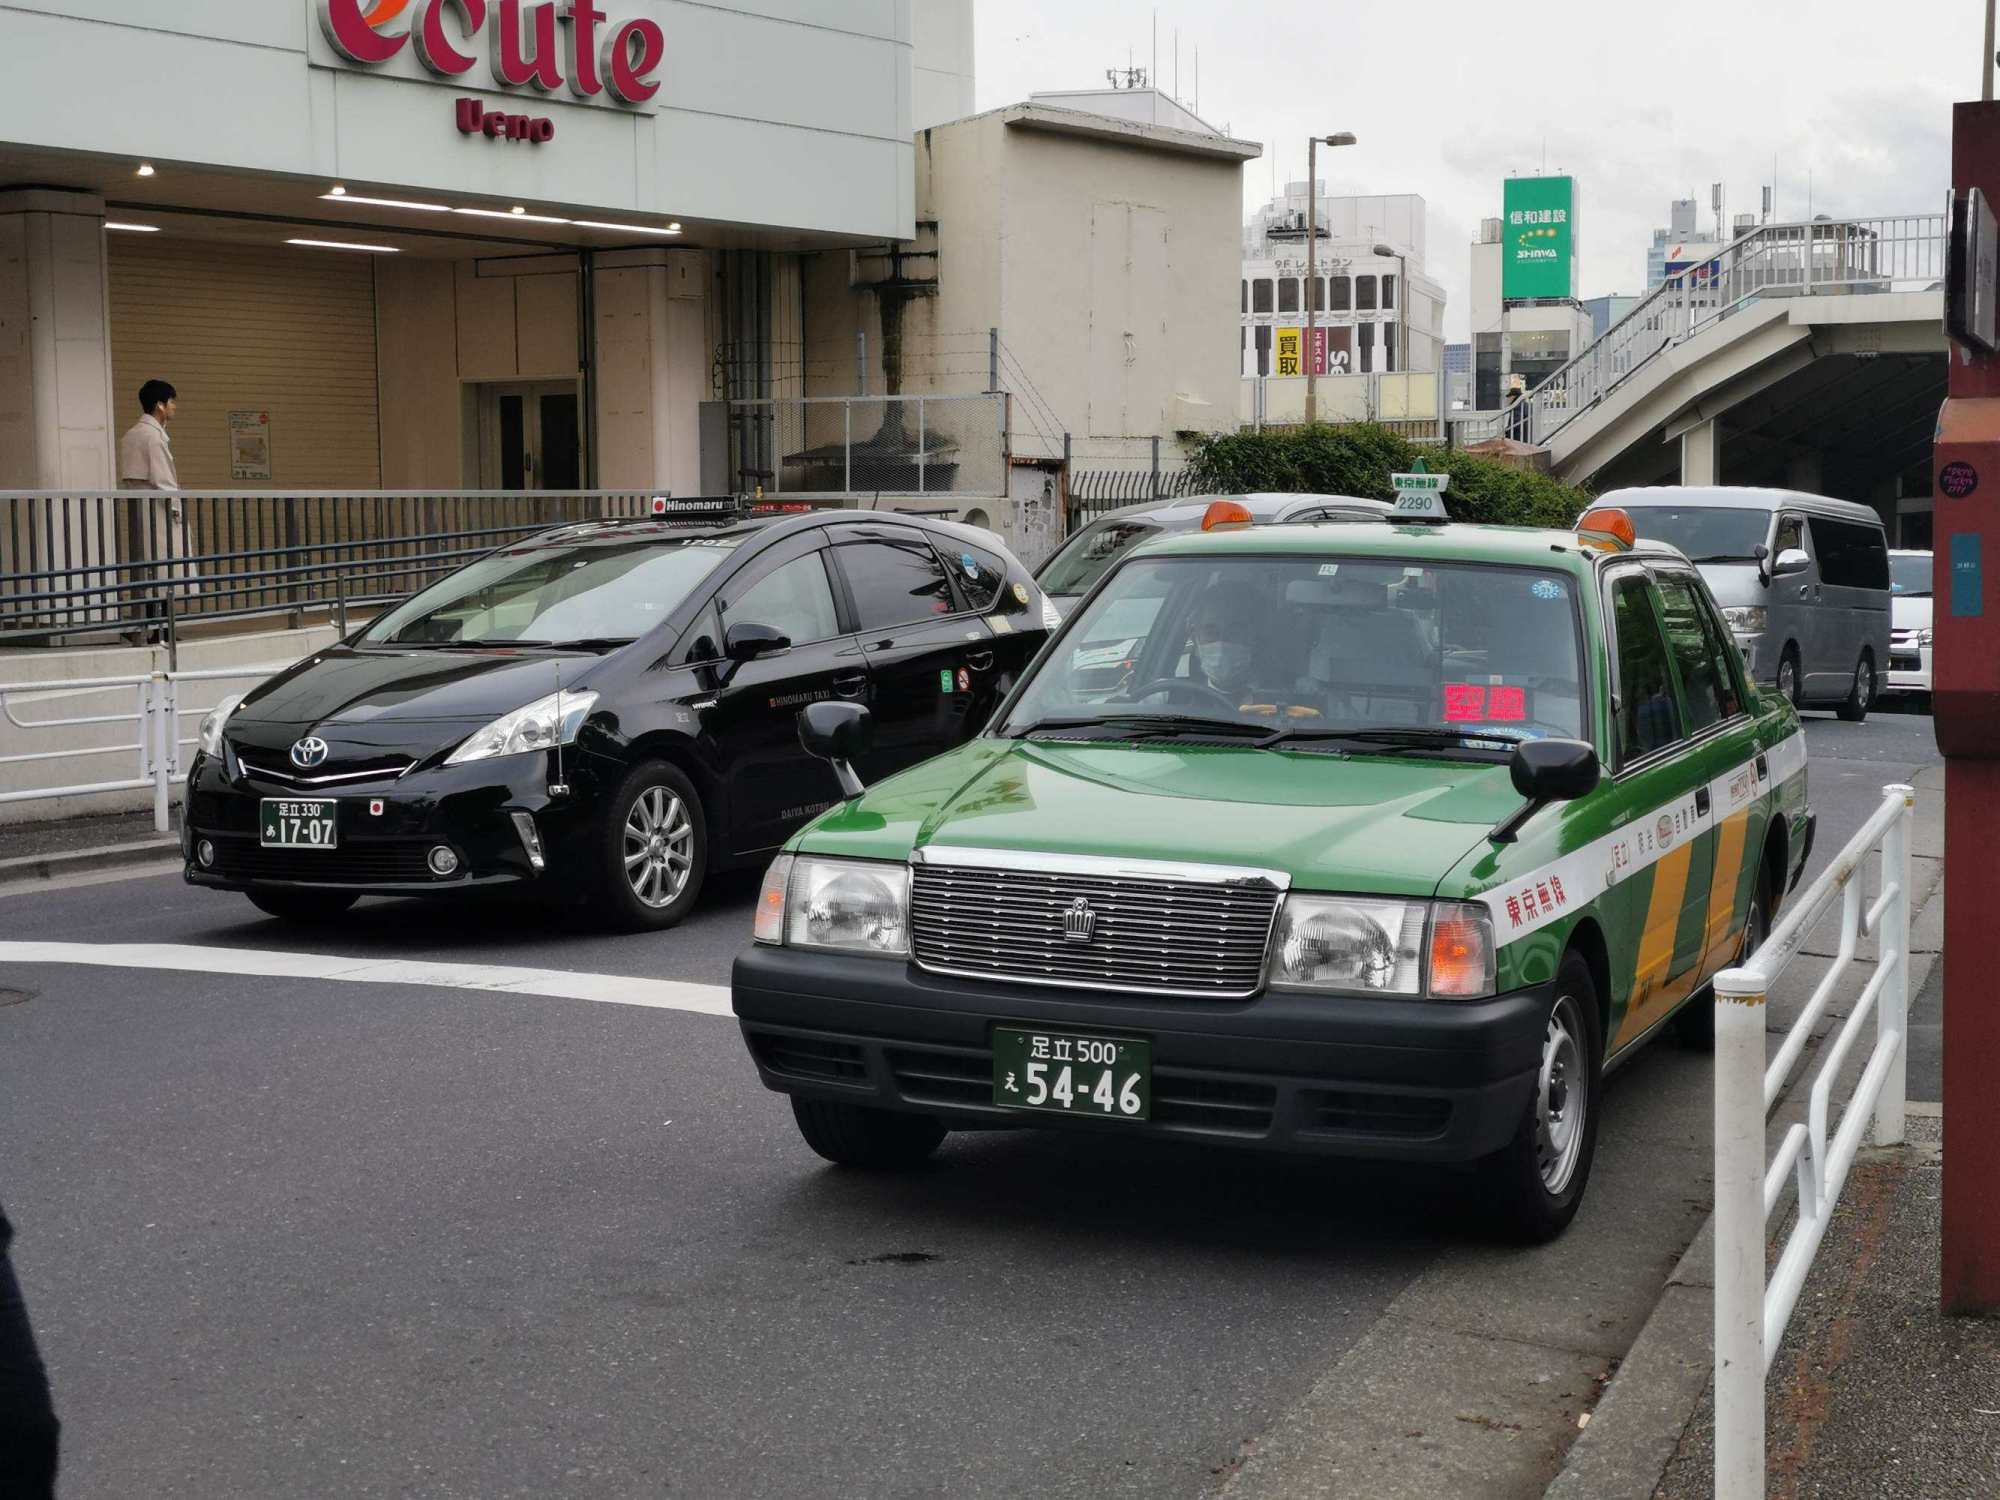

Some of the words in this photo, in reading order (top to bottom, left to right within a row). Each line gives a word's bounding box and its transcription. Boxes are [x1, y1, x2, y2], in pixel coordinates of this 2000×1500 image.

[456, 98, 554, 142] Ueno
[1510, 209, 1566, 224] 信和建設
[1296, 258, 1353, 269] レトラン
[1280, 336, 1298, 375] 買取
[1395, 477, 1439, 489] 東京無線
[666, 500, 723, 512] Hinomaru
[1399, 497, 1433, 510] 2290
[776, 693, 813, 704] HINOMARU
[814, 690, 831, 700] TAXI
[279, 802, 300, 816] 足立
[301, 803, 321, 817] 330
[266, 824, 276, 838] あ
[280, 818, 333, 844] 17-07
[1505, 874, 1567, 929] 東京無線
[1031, 1036, 1073, 1061] 足立
[1077, 1040, 1116, 1065] 500
[1004, 1071, 1020, 1093] え
[1026, 1062, 1141, 1115] 54-46
